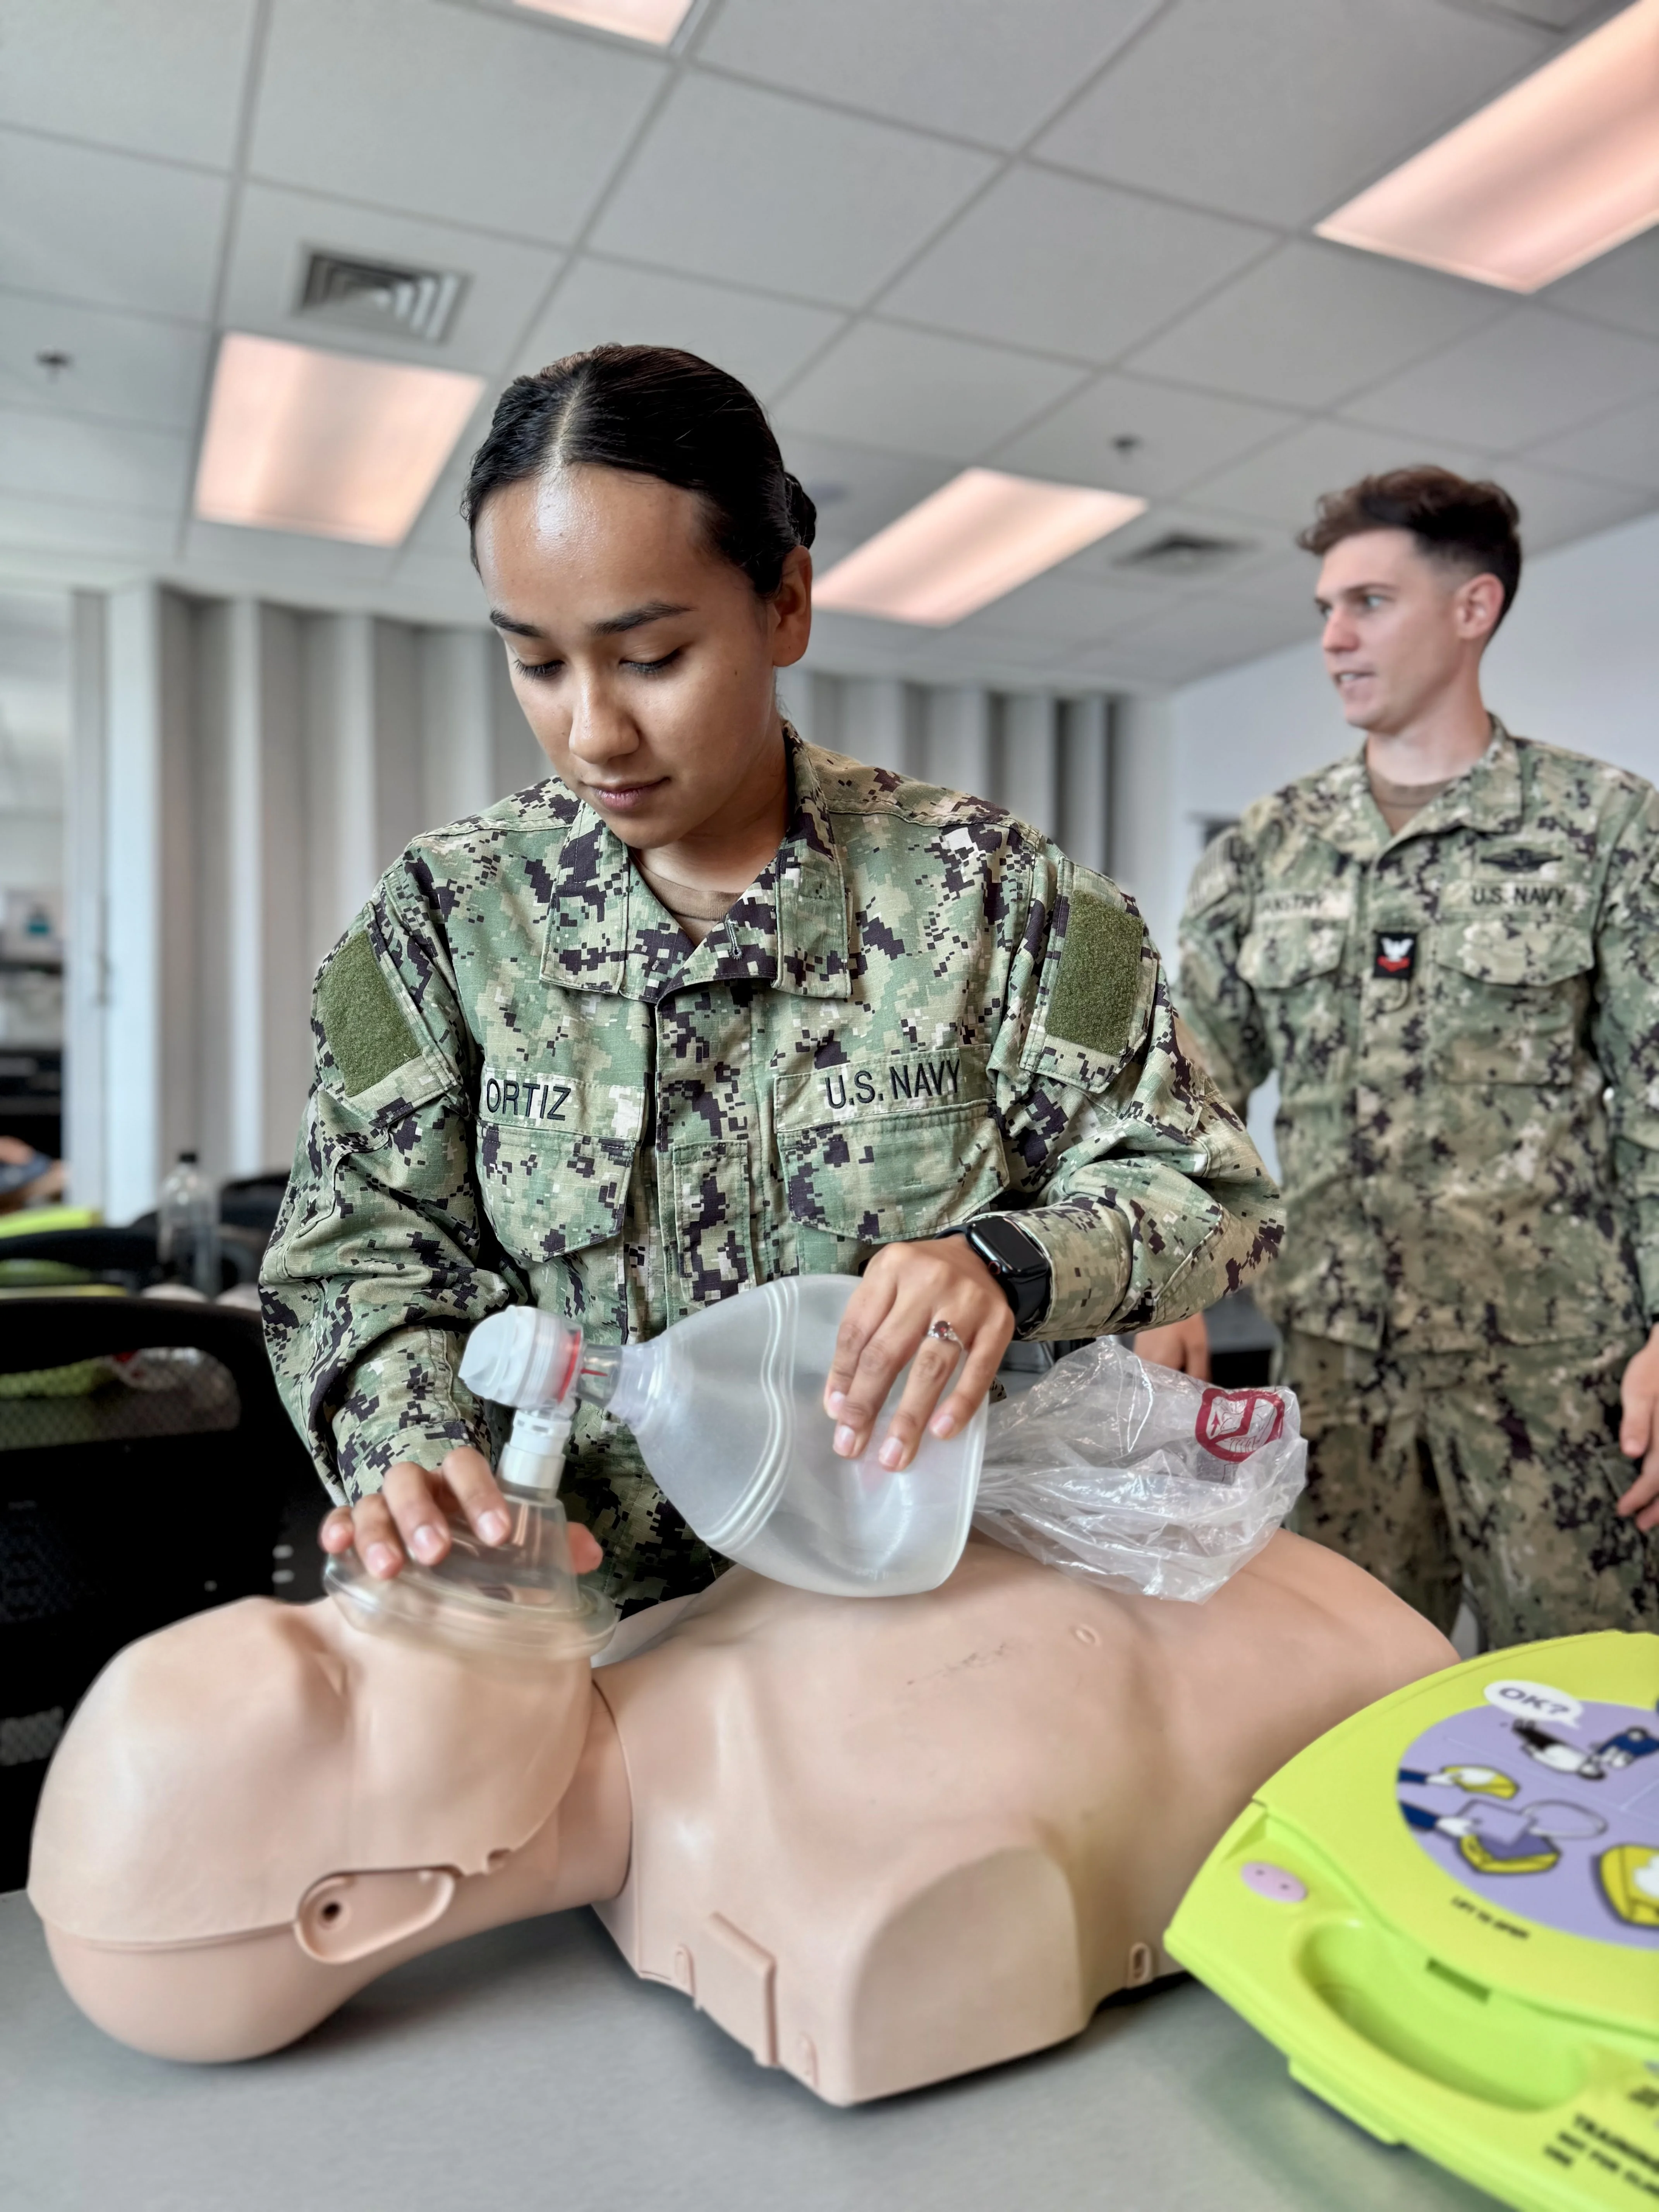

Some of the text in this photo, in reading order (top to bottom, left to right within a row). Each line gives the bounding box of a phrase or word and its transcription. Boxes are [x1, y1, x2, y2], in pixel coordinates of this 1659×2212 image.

[1472, 885, 1566, 907] U.S. NAVY
[486, 1078, 571, 1121] ORTIZ
[824, 1059, 960, 1109] U.S. NAVY
[1499, 1687, 1570, 1715] OK?
